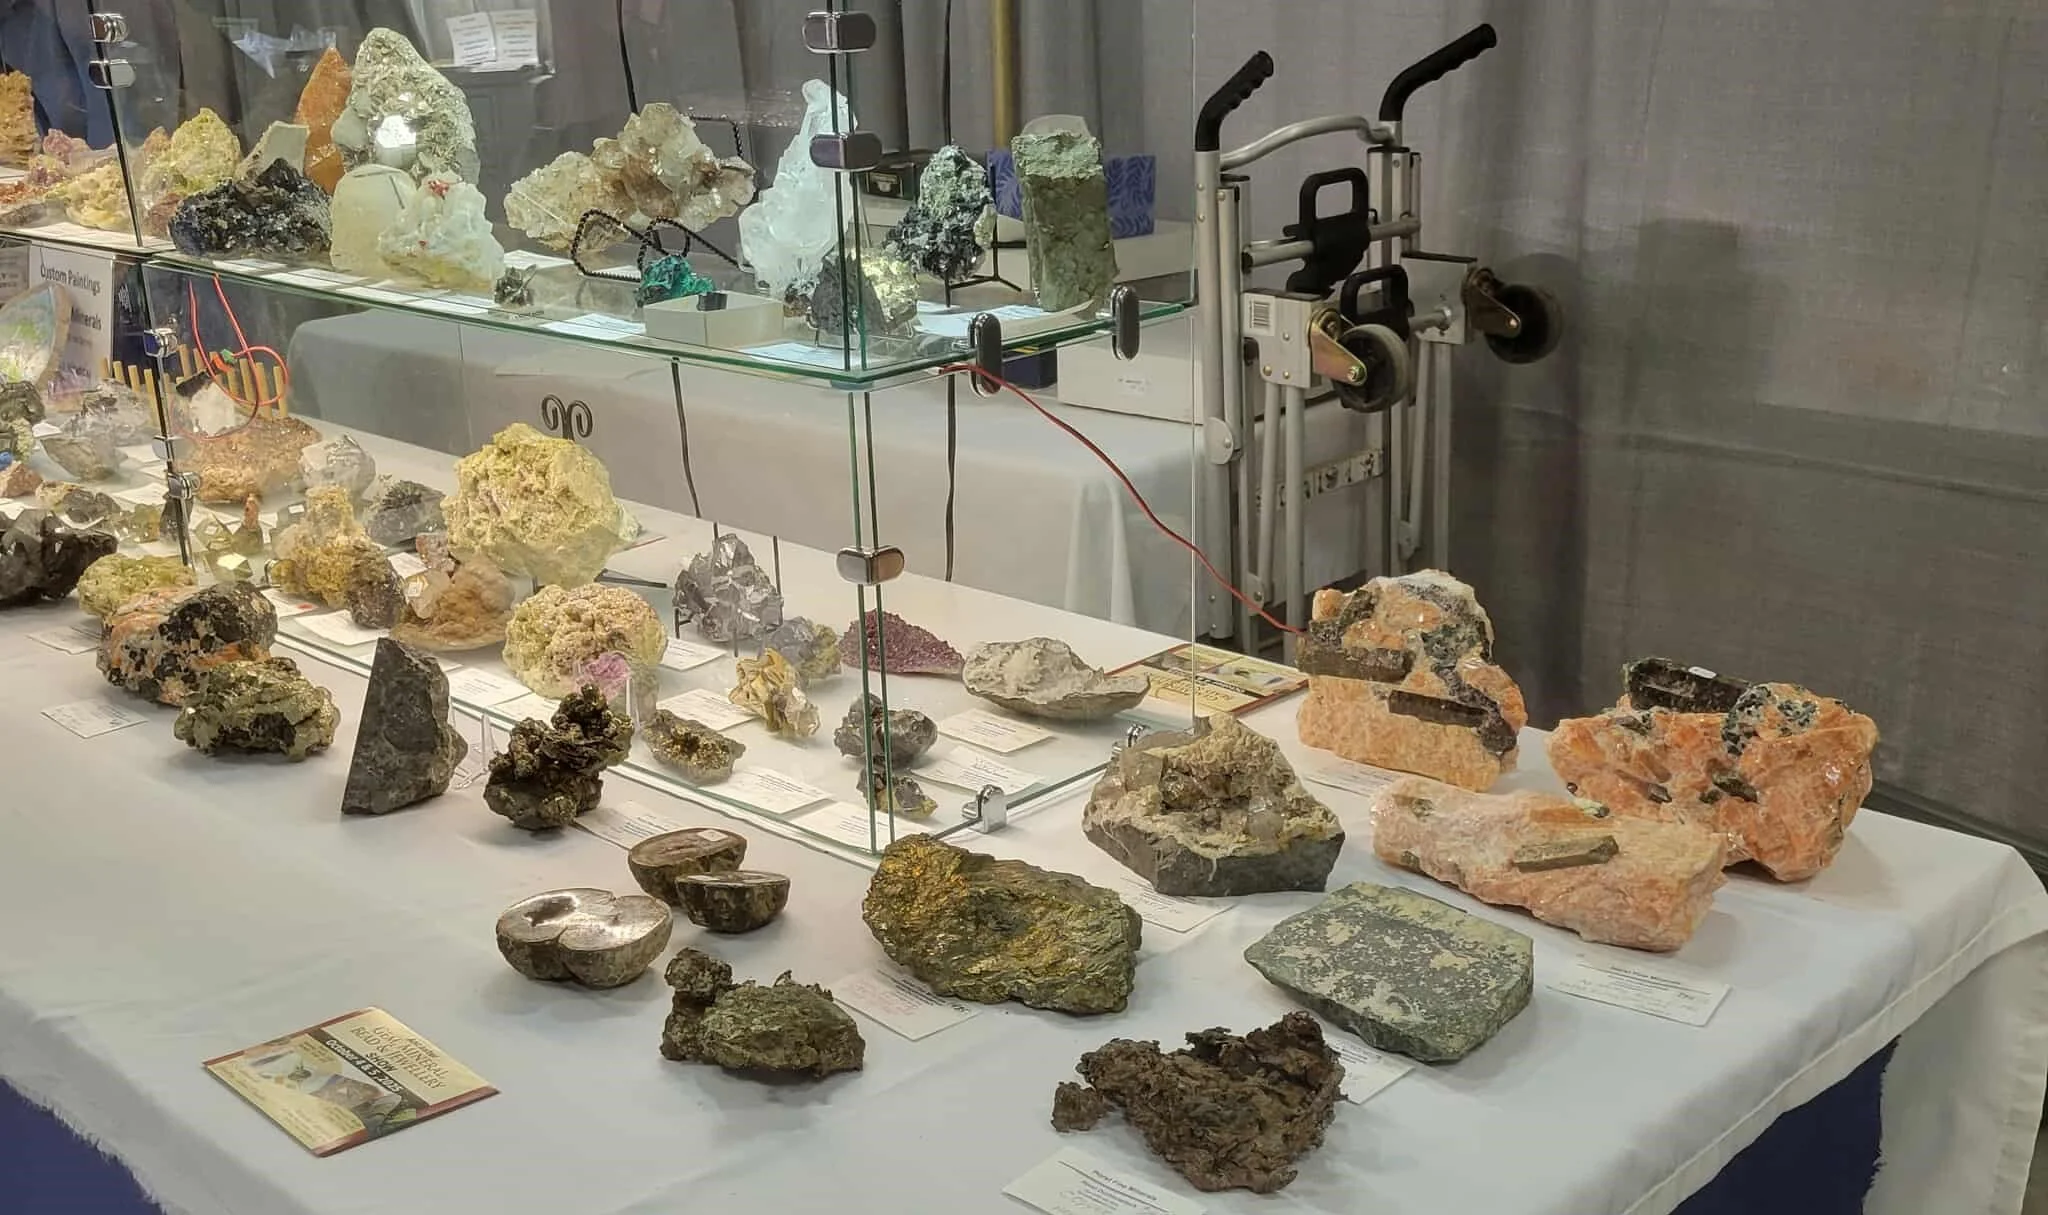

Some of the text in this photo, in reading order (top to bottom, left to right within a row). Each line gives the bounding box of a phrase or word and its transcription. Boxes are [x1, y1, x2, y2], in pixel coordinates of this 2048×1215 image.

[41, 264, 67, 283] Custom
[67, 269, 101, 296] Paintings
[71, 305, 101, 331] Minerals
[325, 1039, 356, 1062] October
[350, 1026, 447, 1089] BEAD & JEWELLERY
[365, 1052, 398, 1072] SHOW
